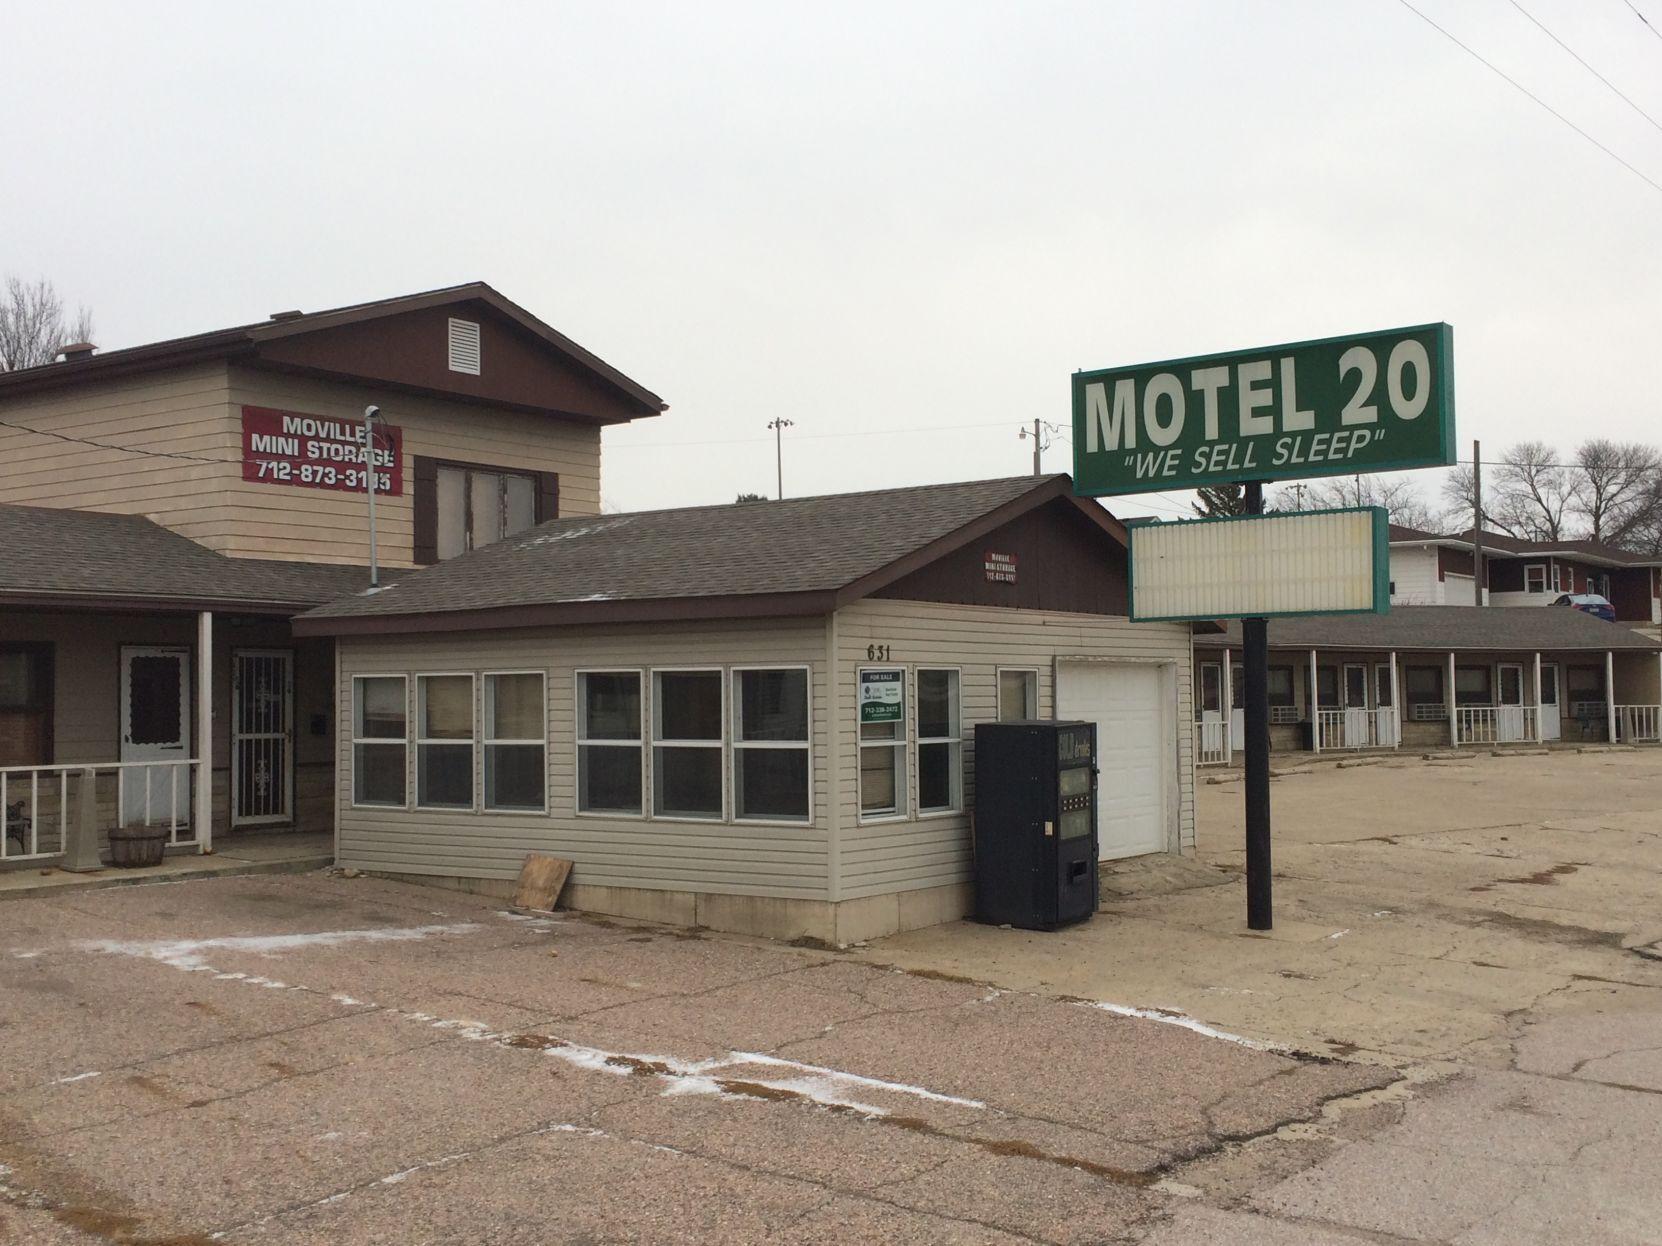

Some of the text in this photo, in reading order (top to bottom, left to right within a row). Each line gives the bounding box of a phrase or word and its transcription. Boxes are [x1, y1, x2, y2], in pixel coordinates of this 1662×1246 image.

[1084, 339, 1432, 453] MOTEL 20
[282, 415, 368, 444] MOVILLE
[251, 433, 395, 468] MINI STORAGE
[1123, 428, 1386, 479] "WE SELL SLEEP"
[867, 644, 890, 662] 631
